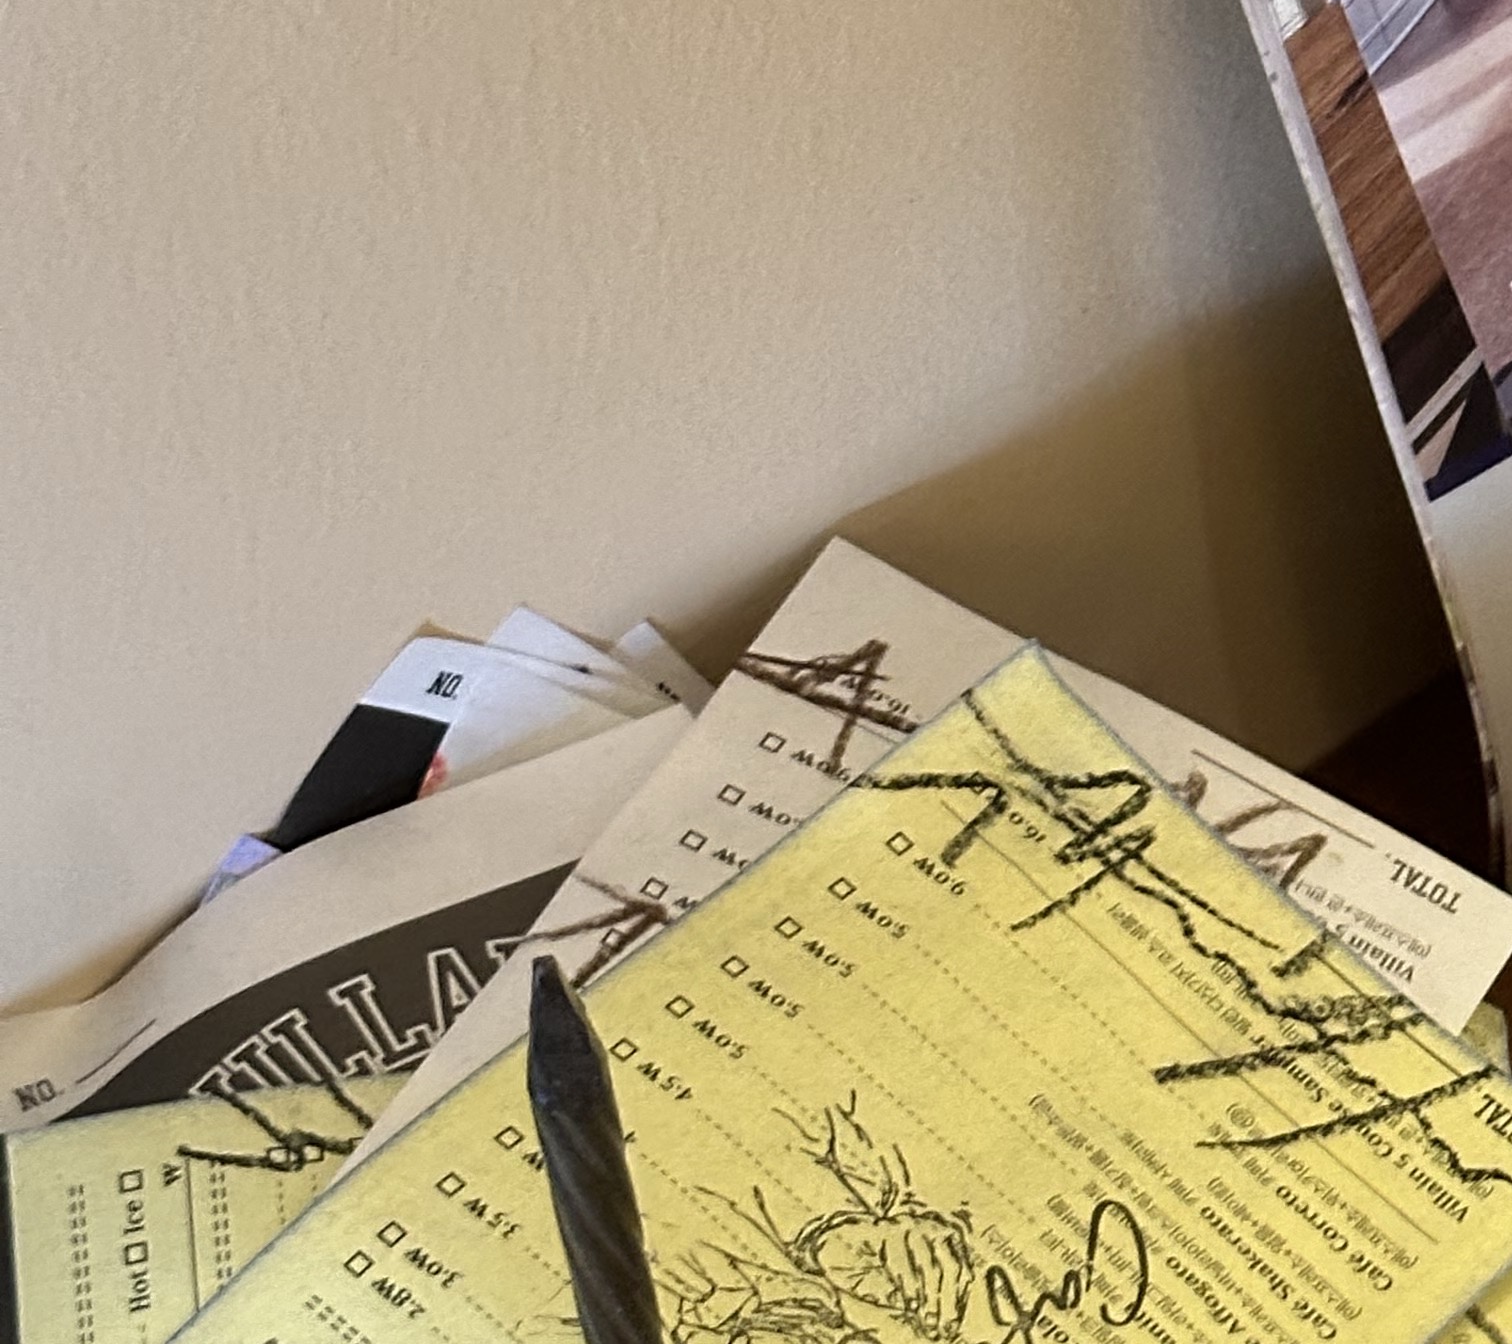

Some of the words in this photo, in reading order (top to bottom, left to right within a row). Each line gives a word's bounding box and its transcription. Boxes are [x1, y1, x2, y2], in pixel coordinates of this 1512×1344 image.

[908, 844, 971, 904] 9.0W
[852, 888, 912, 946] 5.0W
[798, 928, 858, 985] 5.0W
[744, 966, 806, 1025] 5.0W
[689, 1007, 750, 1065] 5.0W
[1391, 1146, 1416, 1172] 5
[121, 1198, 145, 1234] Ice
[1270, 1179, 1353, 1257] Correto
[1401, 1159, 1474, 1229] Villain
[403, 1235, 463, 1294] 3.0W
[1190, 1201, 1301, 1305] Shakerato
[1342, 1245, 1396, 1298] Café
[125, 1267, 152, 1313] Hot
[367, 1267, 429, 1326] 2.8W
[1155, 1251, 1252, 1342] Affogato
[1288, 1292, 1342, 1344] Café
